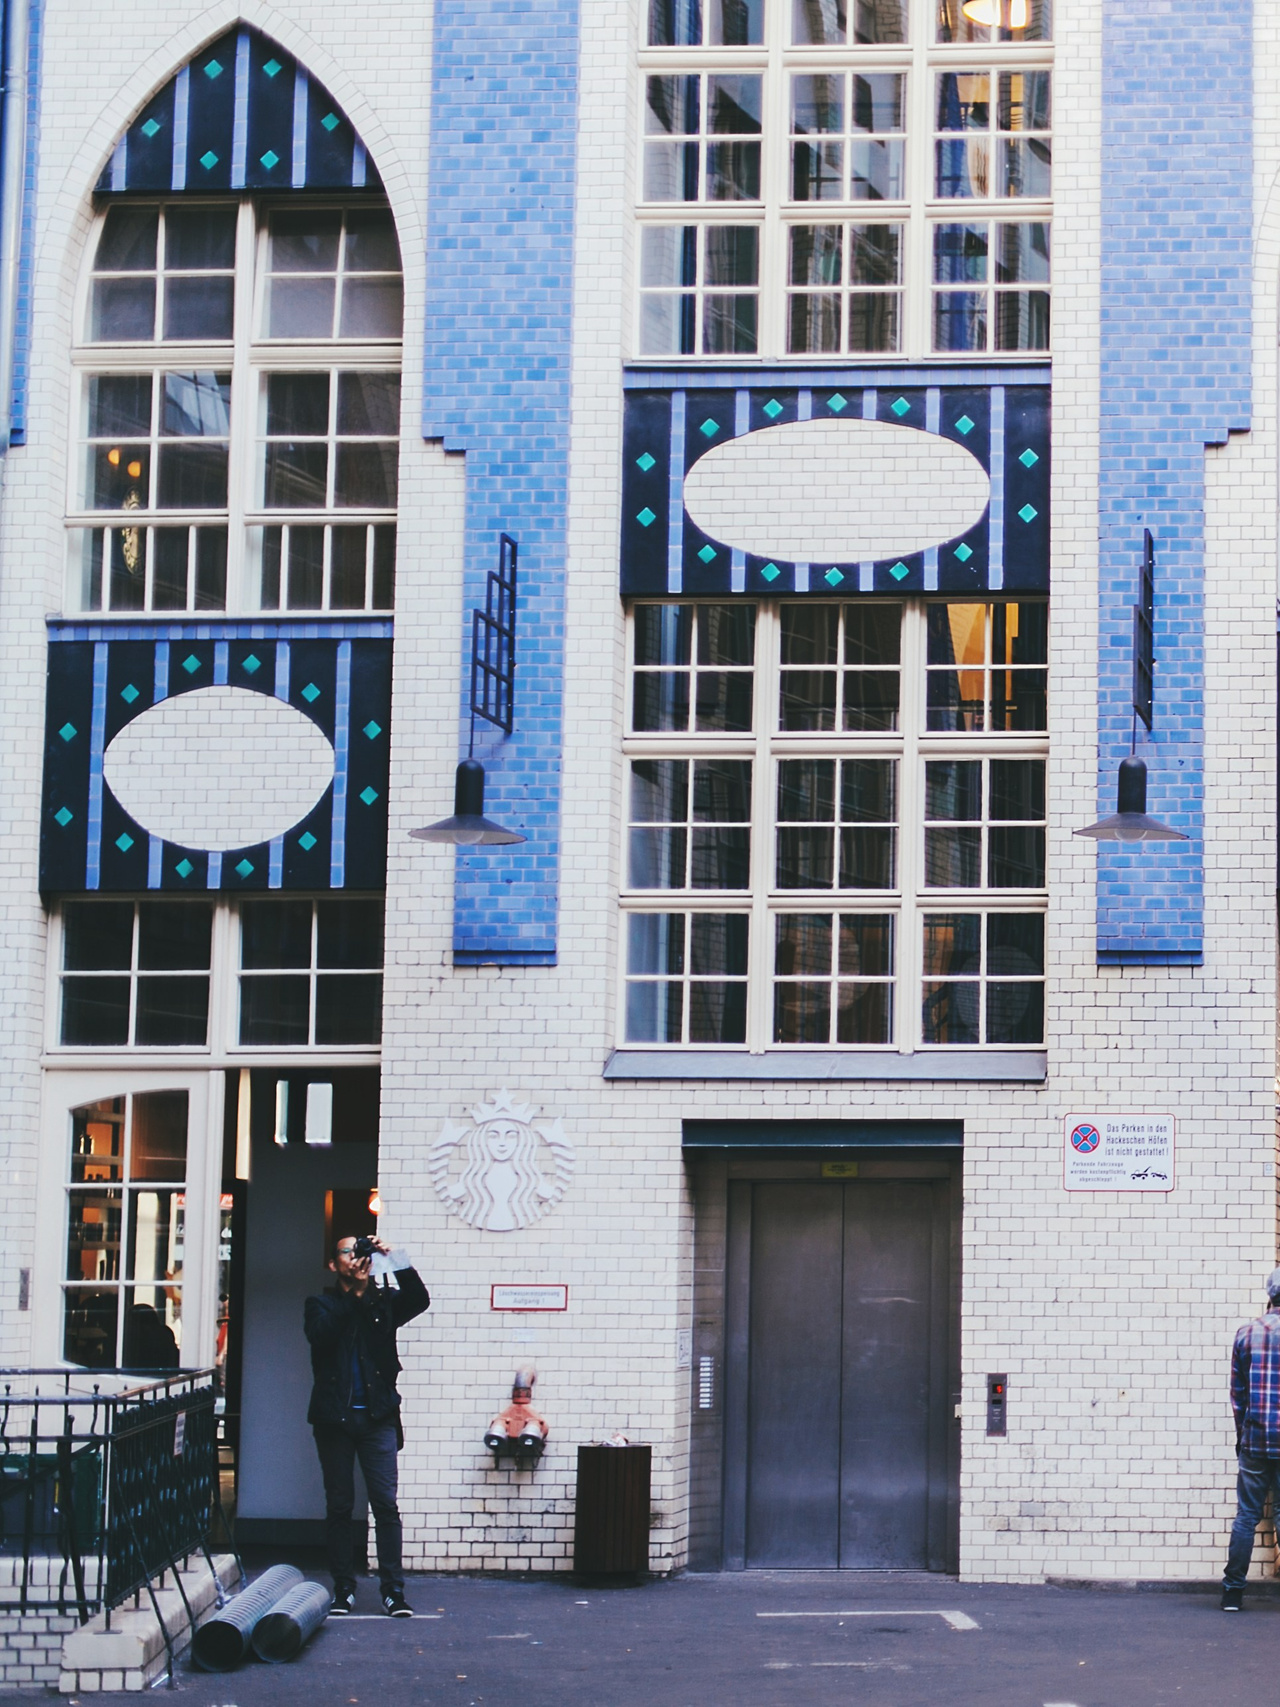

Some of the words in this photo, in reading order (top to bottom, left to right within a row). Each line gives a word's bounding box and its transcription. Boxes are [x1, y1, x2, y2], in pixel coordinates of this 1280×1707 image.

[1106, 1123, 1119, 1133] Das
[1121, 1123, 1145, 1133] Parken
[1146, 1123, 1154, 1133] in
[1156, 1123, 1168, 1133] den
[1106, 1136, 1145, 1145] Hackeschen
[1148, 1136, 1168, 1145] Höfen
[1104, 1147, 1114, 1156] ist
[1116, 1147, 1132, 1156] nicht
